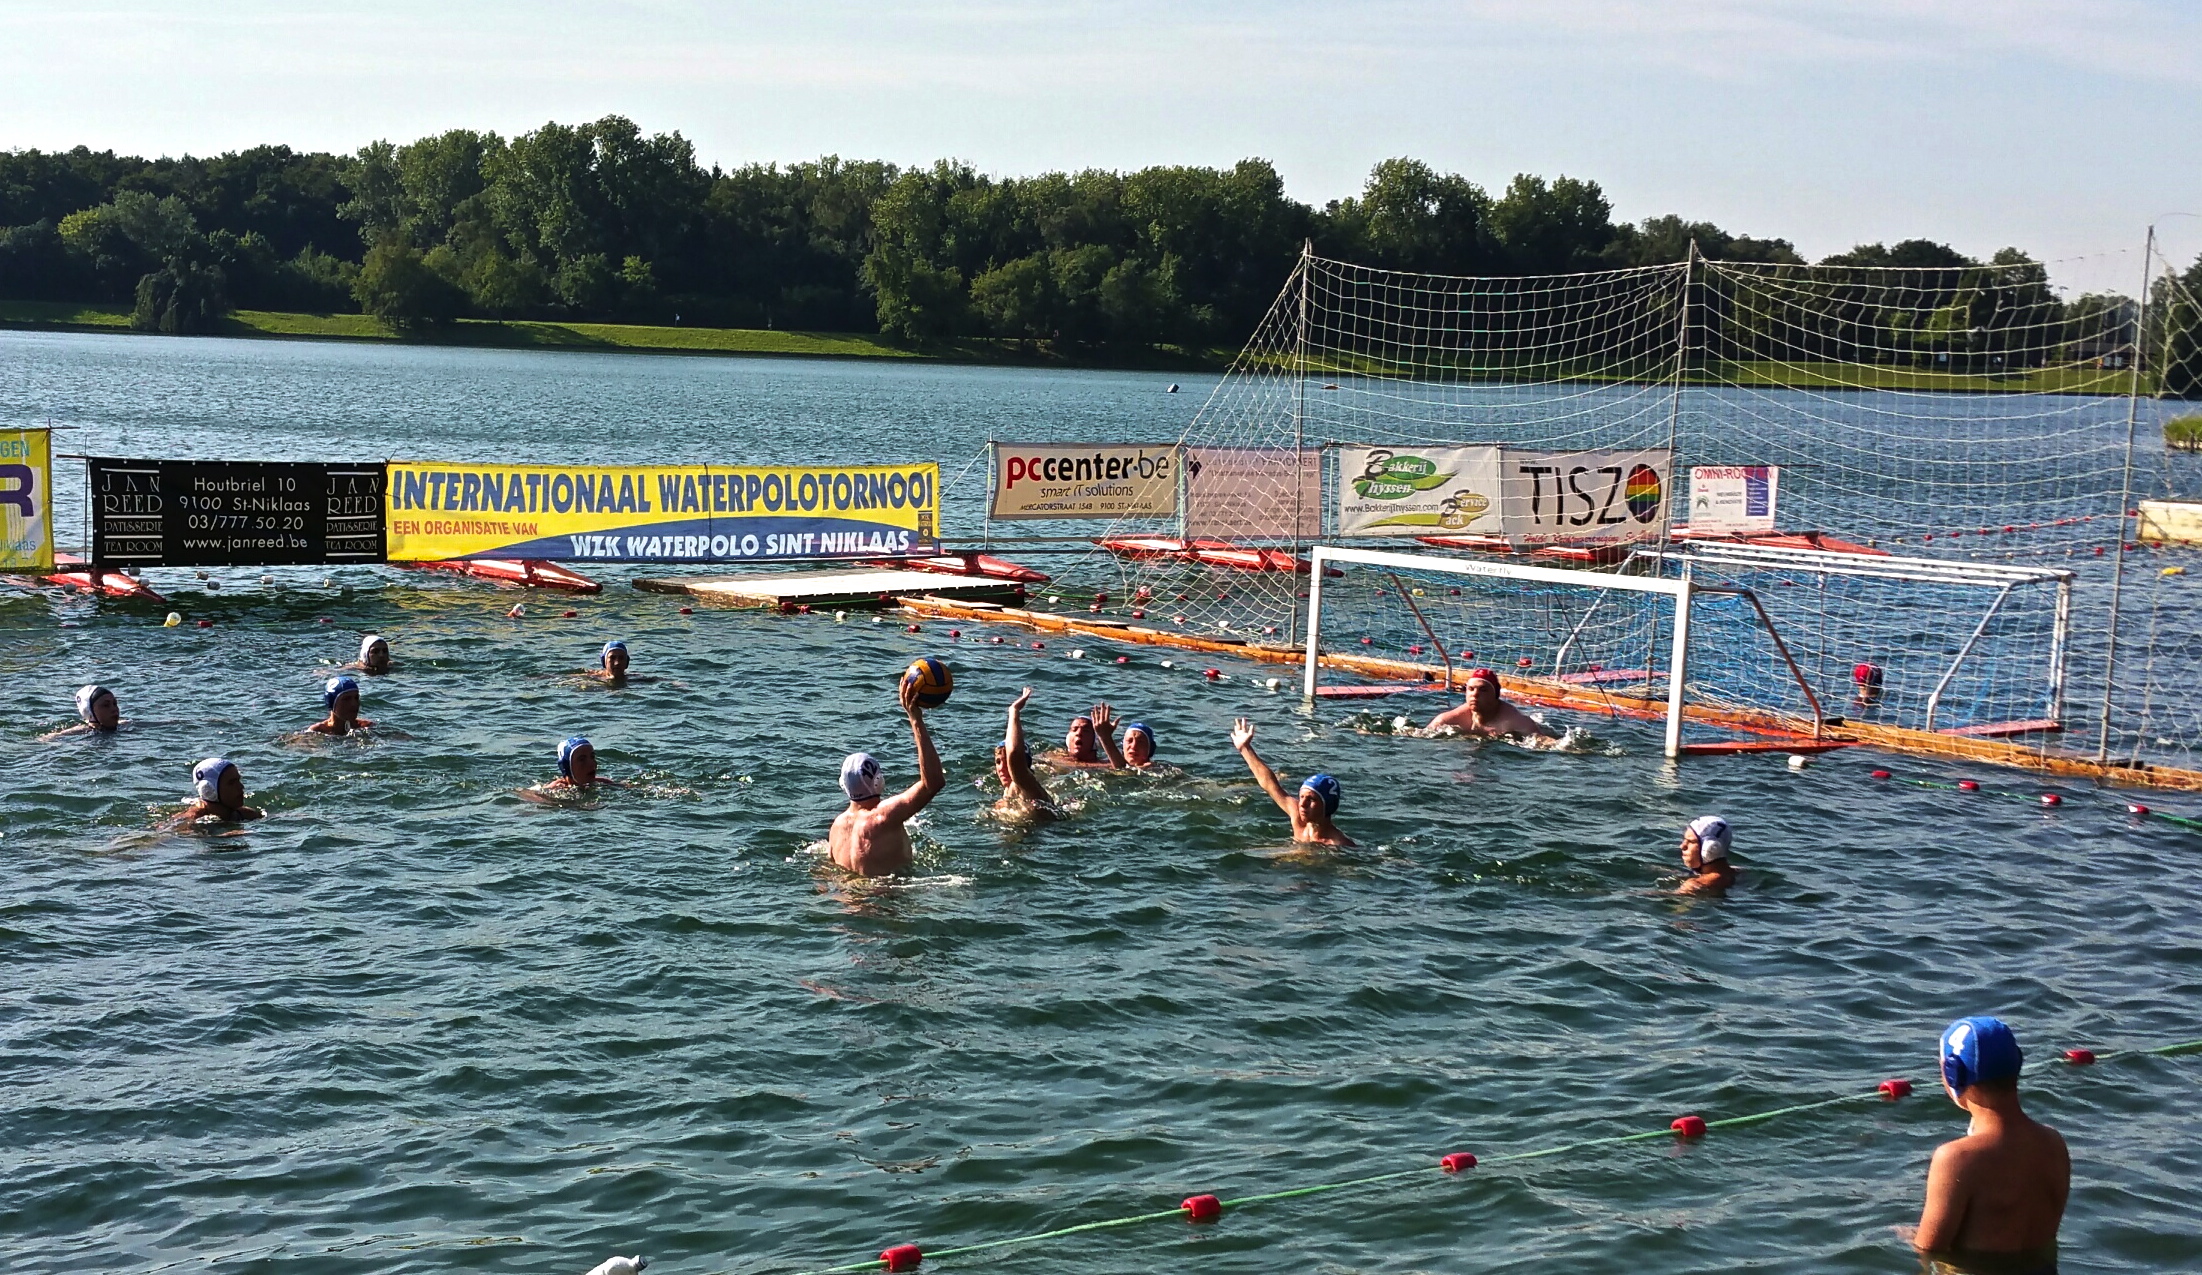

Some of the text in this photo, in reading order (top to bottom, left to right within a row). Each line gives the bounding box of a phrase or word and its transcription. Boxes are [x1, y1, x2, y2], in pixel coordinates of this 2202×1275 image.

[1262, 456, 1318, 468] FRANCKERT
[102, 474, 160, 493] JAN
[194, 476, 296, 492] Houtbriel 10
[326, 477, 380, 495] JAN
[393, 470, 933, 514] INTERNATIONAAL WATERPOLOTORNOOI
[1041, 487, 1071, 499] smart
[1085, 483, 1134, 497] solutions
[179, 495, 311, 511] 9100 St-Niklaas
[1519, 463, 1662, 526] TISZO
[103, 494, 163, 513] REED
[327, 495, 378, 515] REED
[1100, 502, 1115, 510] 9100
[104, 521, 163, 532] PATISSERIE
[188, 514, 304, 531] 03/777.50.20
[326, 520, 378, 533] PATISSERIE
[394, 520, 538, 536] EEN ORGANISATIE VAN
[104, 541, 163, 552] TEA ROOM
[183, 533, 308, 553] www.janreed.be
[325, 539, 378, 551] TEA ROOM
[570, 531, 909, 558] WZK WATERPOLO SINT NIKLAAS
[1327, 778, 1338, 796] 2
[1948, 1024, 1971, 1056] 4
